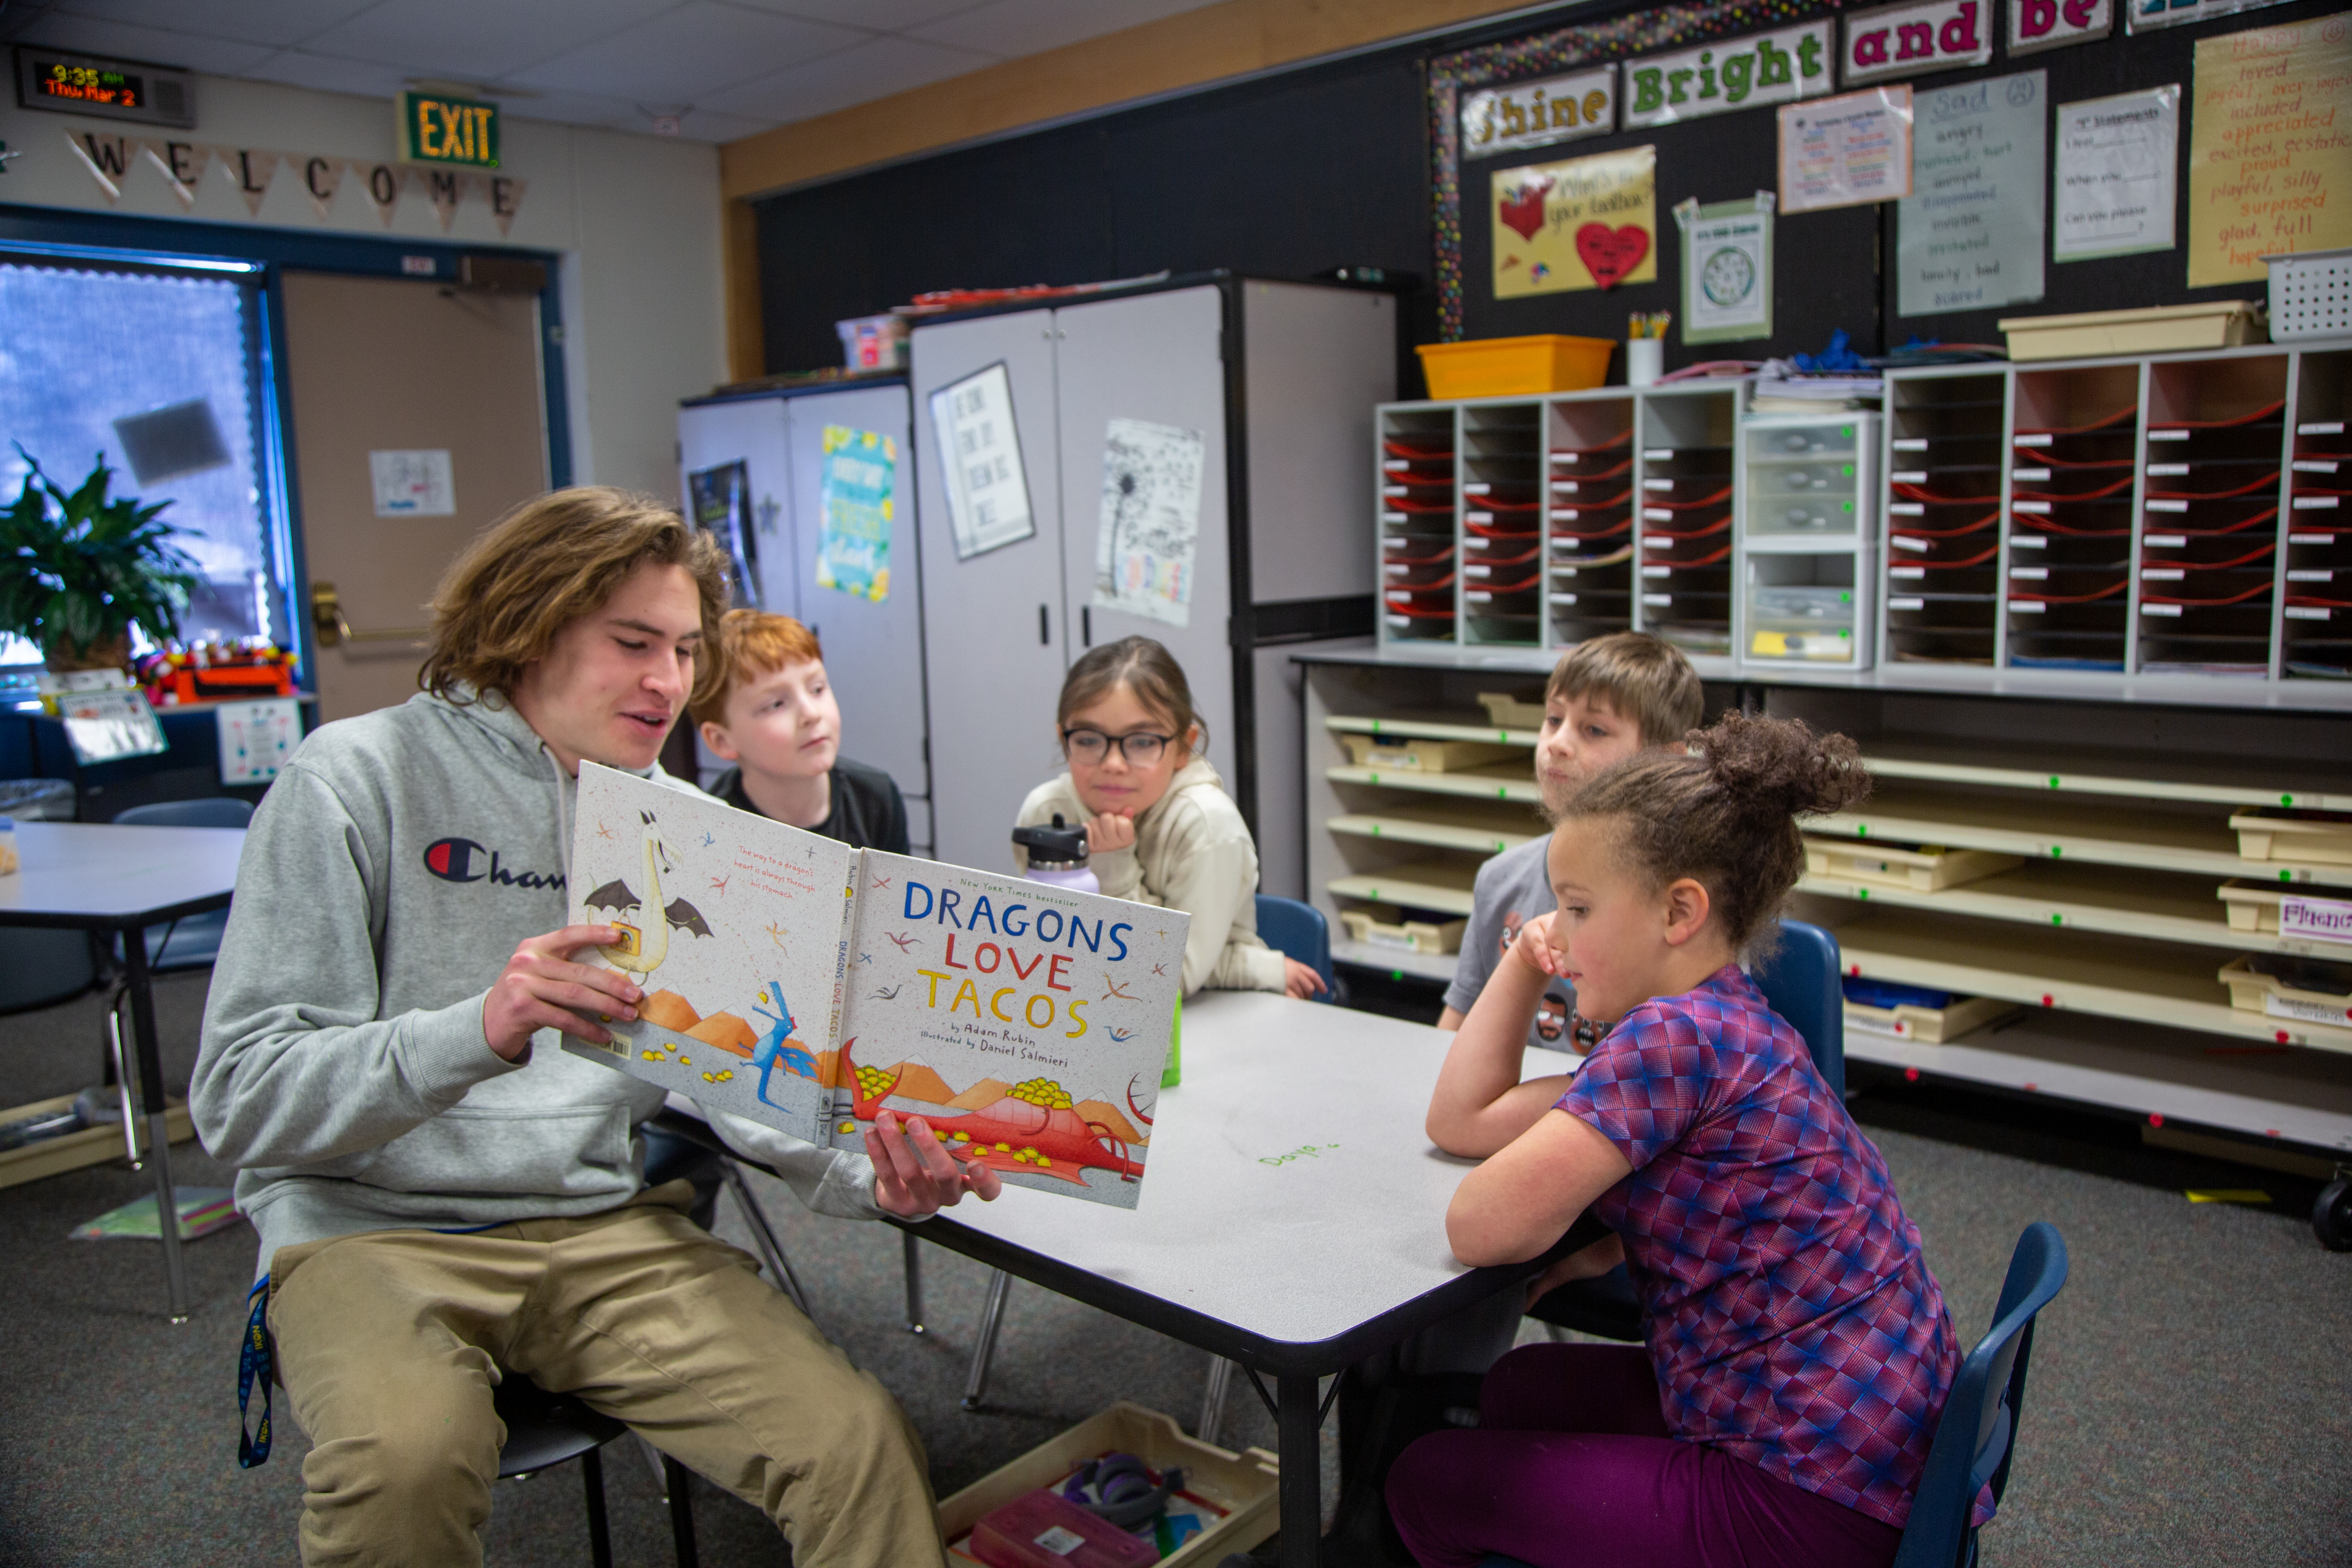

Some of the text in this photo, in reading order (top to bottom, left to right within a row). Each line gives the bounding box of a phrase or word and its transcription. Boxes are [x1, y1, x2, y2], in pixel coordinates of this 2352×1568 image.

[2233, 29, 2301, 54] Happy
[1633, 33, 1823, 113] Bright
[1853, 1, 1980, 67] and
[2240, 58, 2287, 81] loved
[52, 64, 99, 87] 9:35
[121, 89, 135, 107] 2
[1933, 82, 1988, 118] Sad
[2231, 96, 2302, 120] included
[418, 100, 493, 161] EXIT
[2223, 107, 2335, 146] appreciated
[84, 133, 515, 217] WELCOME
[2240, 152, 2290, 181] proud
[2283, 169, 2322, 193] silly
[2241, 189, 2327, 219] surprised
[2274, 214, 2311, 236] full
[734, 859, 753, 871] heart
[762, 869, 784, 883] always
[787, 877, 815, 892] through
[739, 845, 751, 855] The
[753, 852, 767, 863] way
[785, 861, 813, 877] dragon's
[751, 880, 795, 900] his stomach.
[1036, 894, 1078, 907] bestseller
[904, 882, 1133, 961] DRAGONS
[829, 865, 857, 1038] Rubin Salmieri DRAGONS LOVE TACOS
[945, 933, 1074, 991] LOVE
[918, 969, 1088, 1038] TACOS
[951, 1022, 1035, 1046] by Adam Rubin
[921, 1031, 1068, 1067] illustrated by Daniel Salmieri
[252, 1325, 263, 1350] IKON
[258, 1418, 270, 1444] IKON
